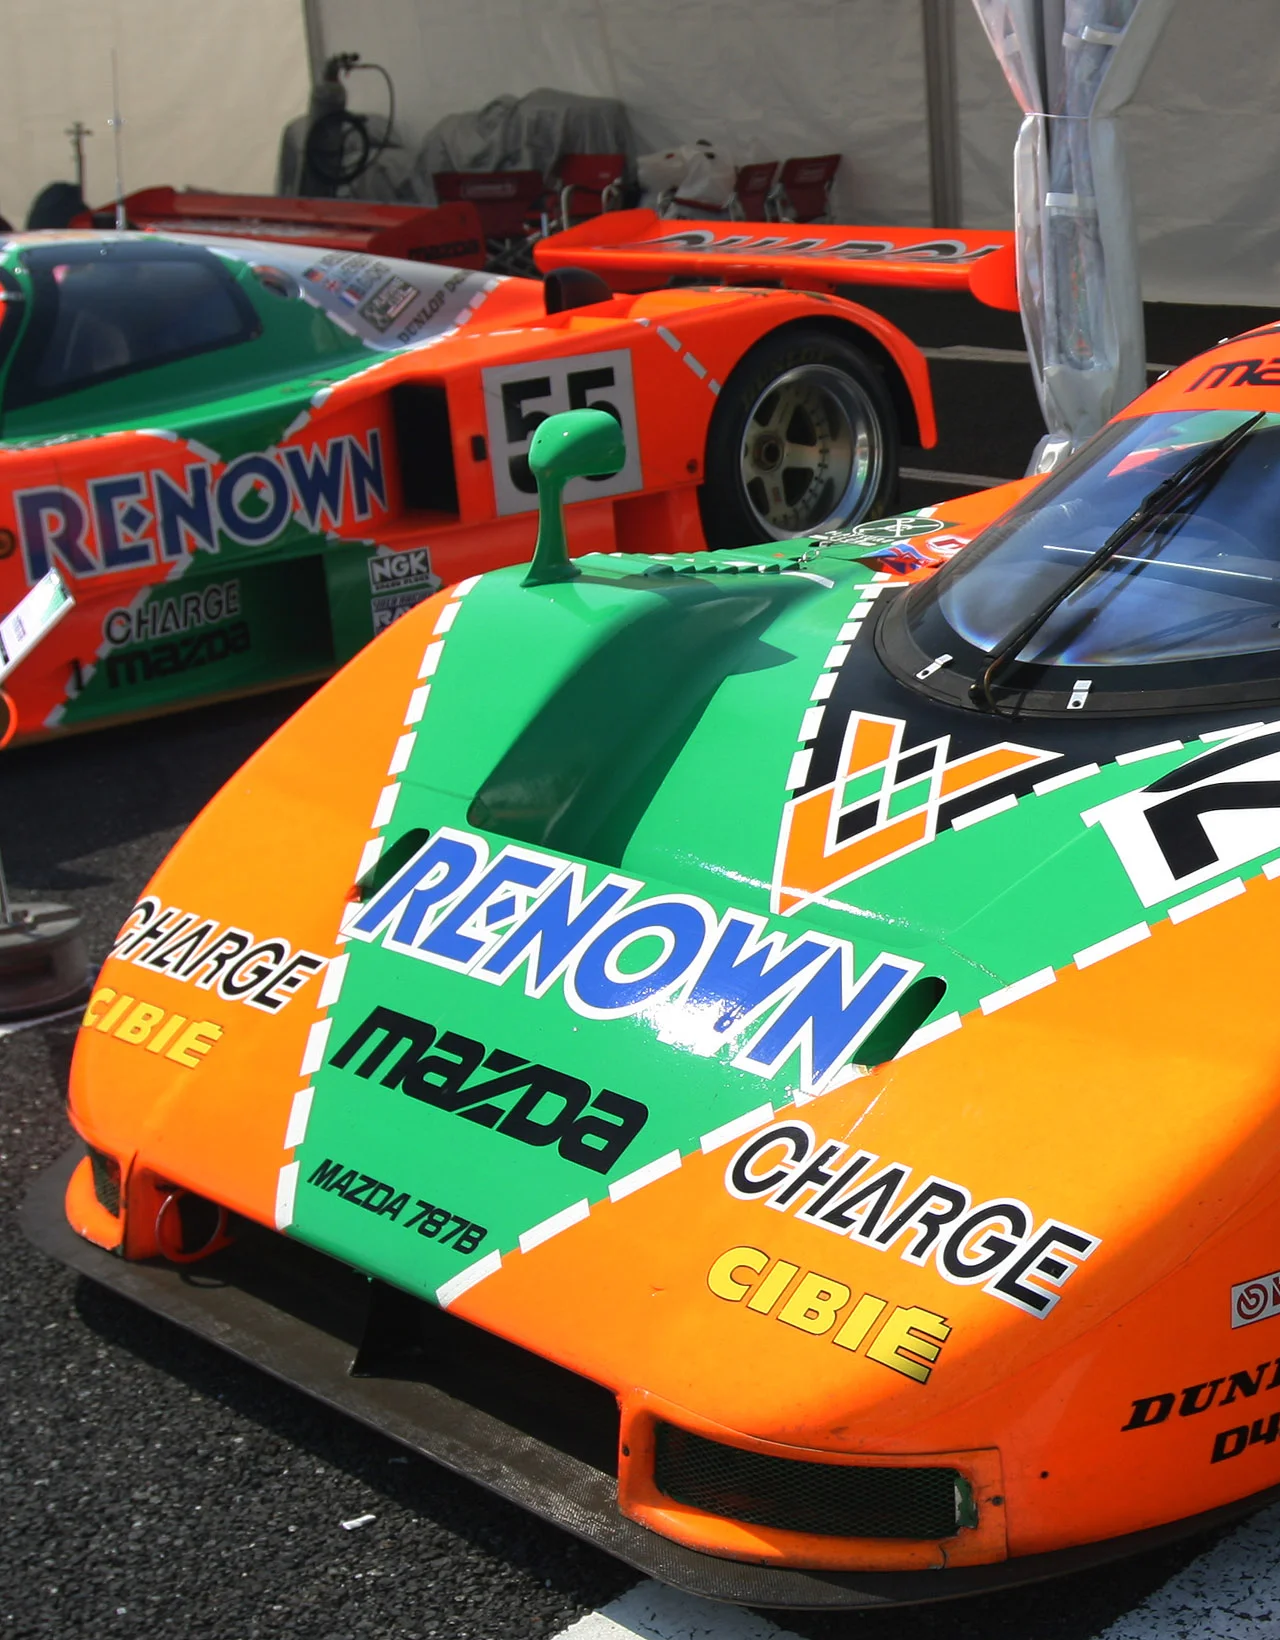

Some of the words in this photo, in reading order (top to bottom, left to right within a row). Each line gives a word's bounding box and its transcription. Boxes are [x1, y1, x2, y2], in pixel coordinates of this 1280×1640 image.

[13, 429, 389, 586] RENOWN
[372, 551, 428, 582] NGK
[103, 579, 241, 646] CHARGE
[109, 897, 328, 1013] CHARGE
[338, 827, 925, 1096] RENOWN
[329, 1006, 648, 1174] mazda
[309, 1159, 406, 1221] MAZDA
[402, 1200, 487, 1254] 787B
[725, 1120, 1102, 1319] CHARGE
